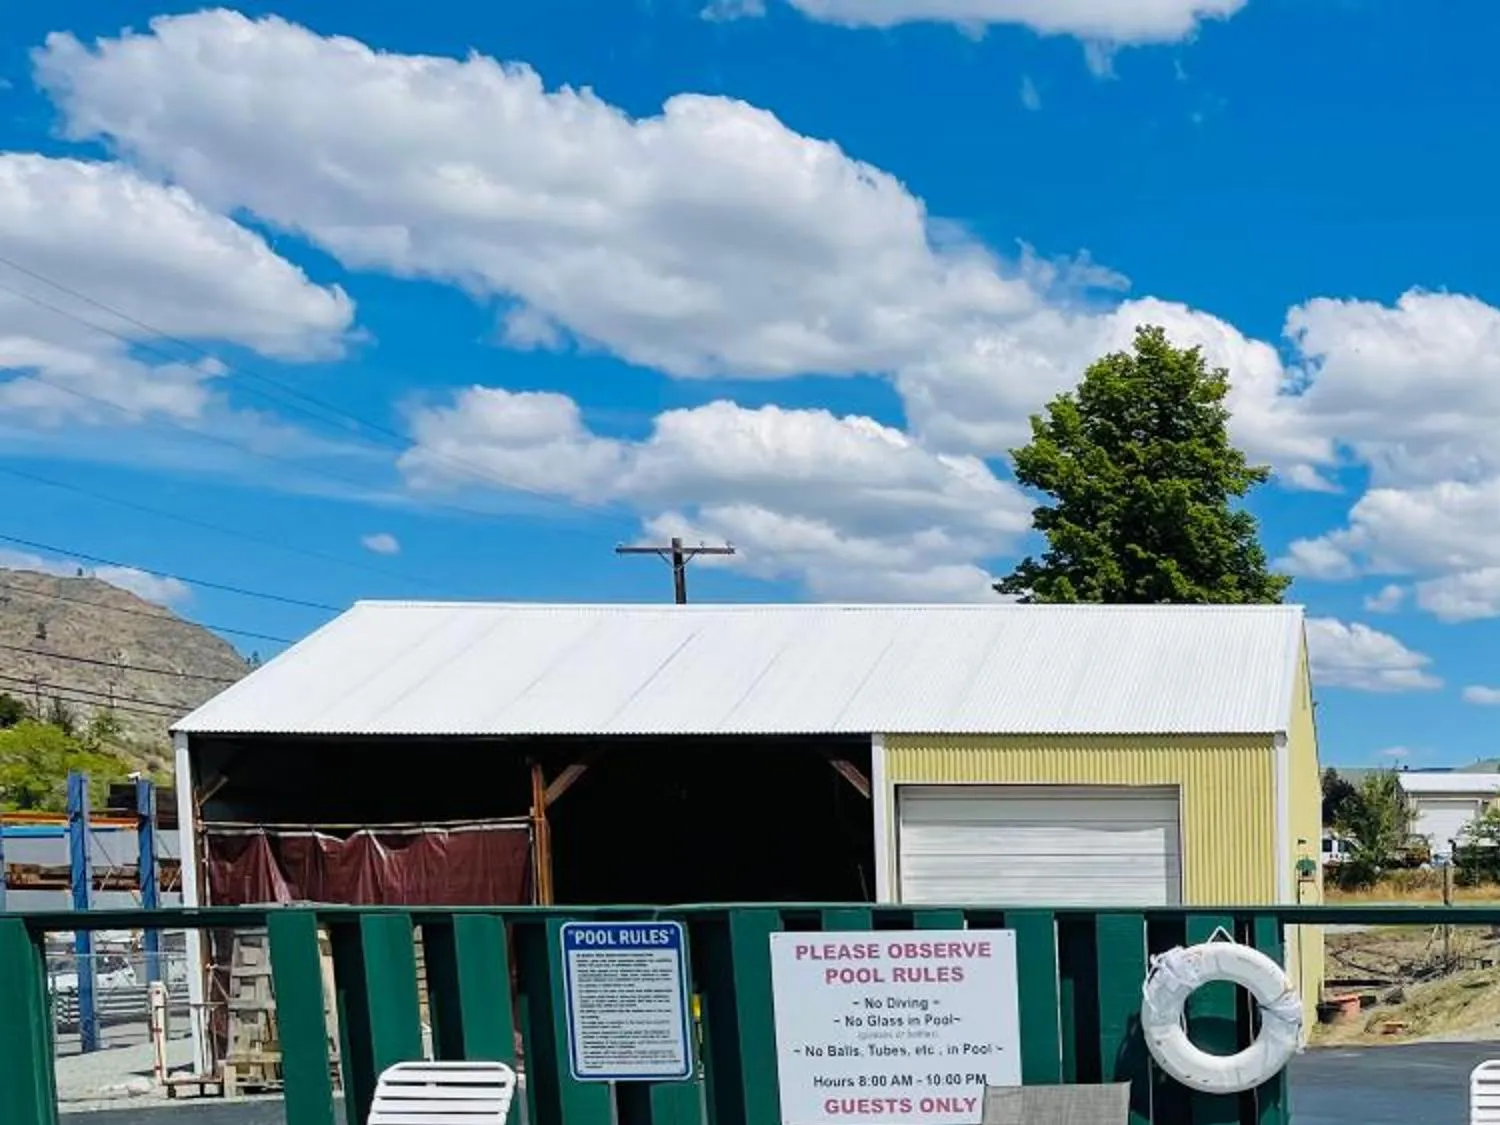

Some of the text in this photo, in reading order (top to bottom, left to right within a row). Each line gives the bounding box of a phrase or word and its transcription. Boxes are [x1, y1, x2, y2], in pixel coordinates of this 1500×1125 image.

[795, 942, 992, 961] PLEASE OBSERVE
[825, 966, 965, 984] POOL RULES
[864, 997, 883, 1009] No
[887, 997, 929, 1011] Diving
[845, 1015, 863, 1027] No
[867, 1015, 904, 1027] Glass
[908, 1015, 921, 1025] in
[805, 1045, 823, 1057] No
[947, 1043, 959, 1055] in
[813, 1076, 855, 1088] Hours
[858, 1075, 888, 1087] 8:00
[891, 1074, 913, 1087] AM
[926, 1074, 962, 1086] 10:00
[965, 1073, 987, 1086] PM
[824, 1097, 978, 1114] GUESTS ONLY
